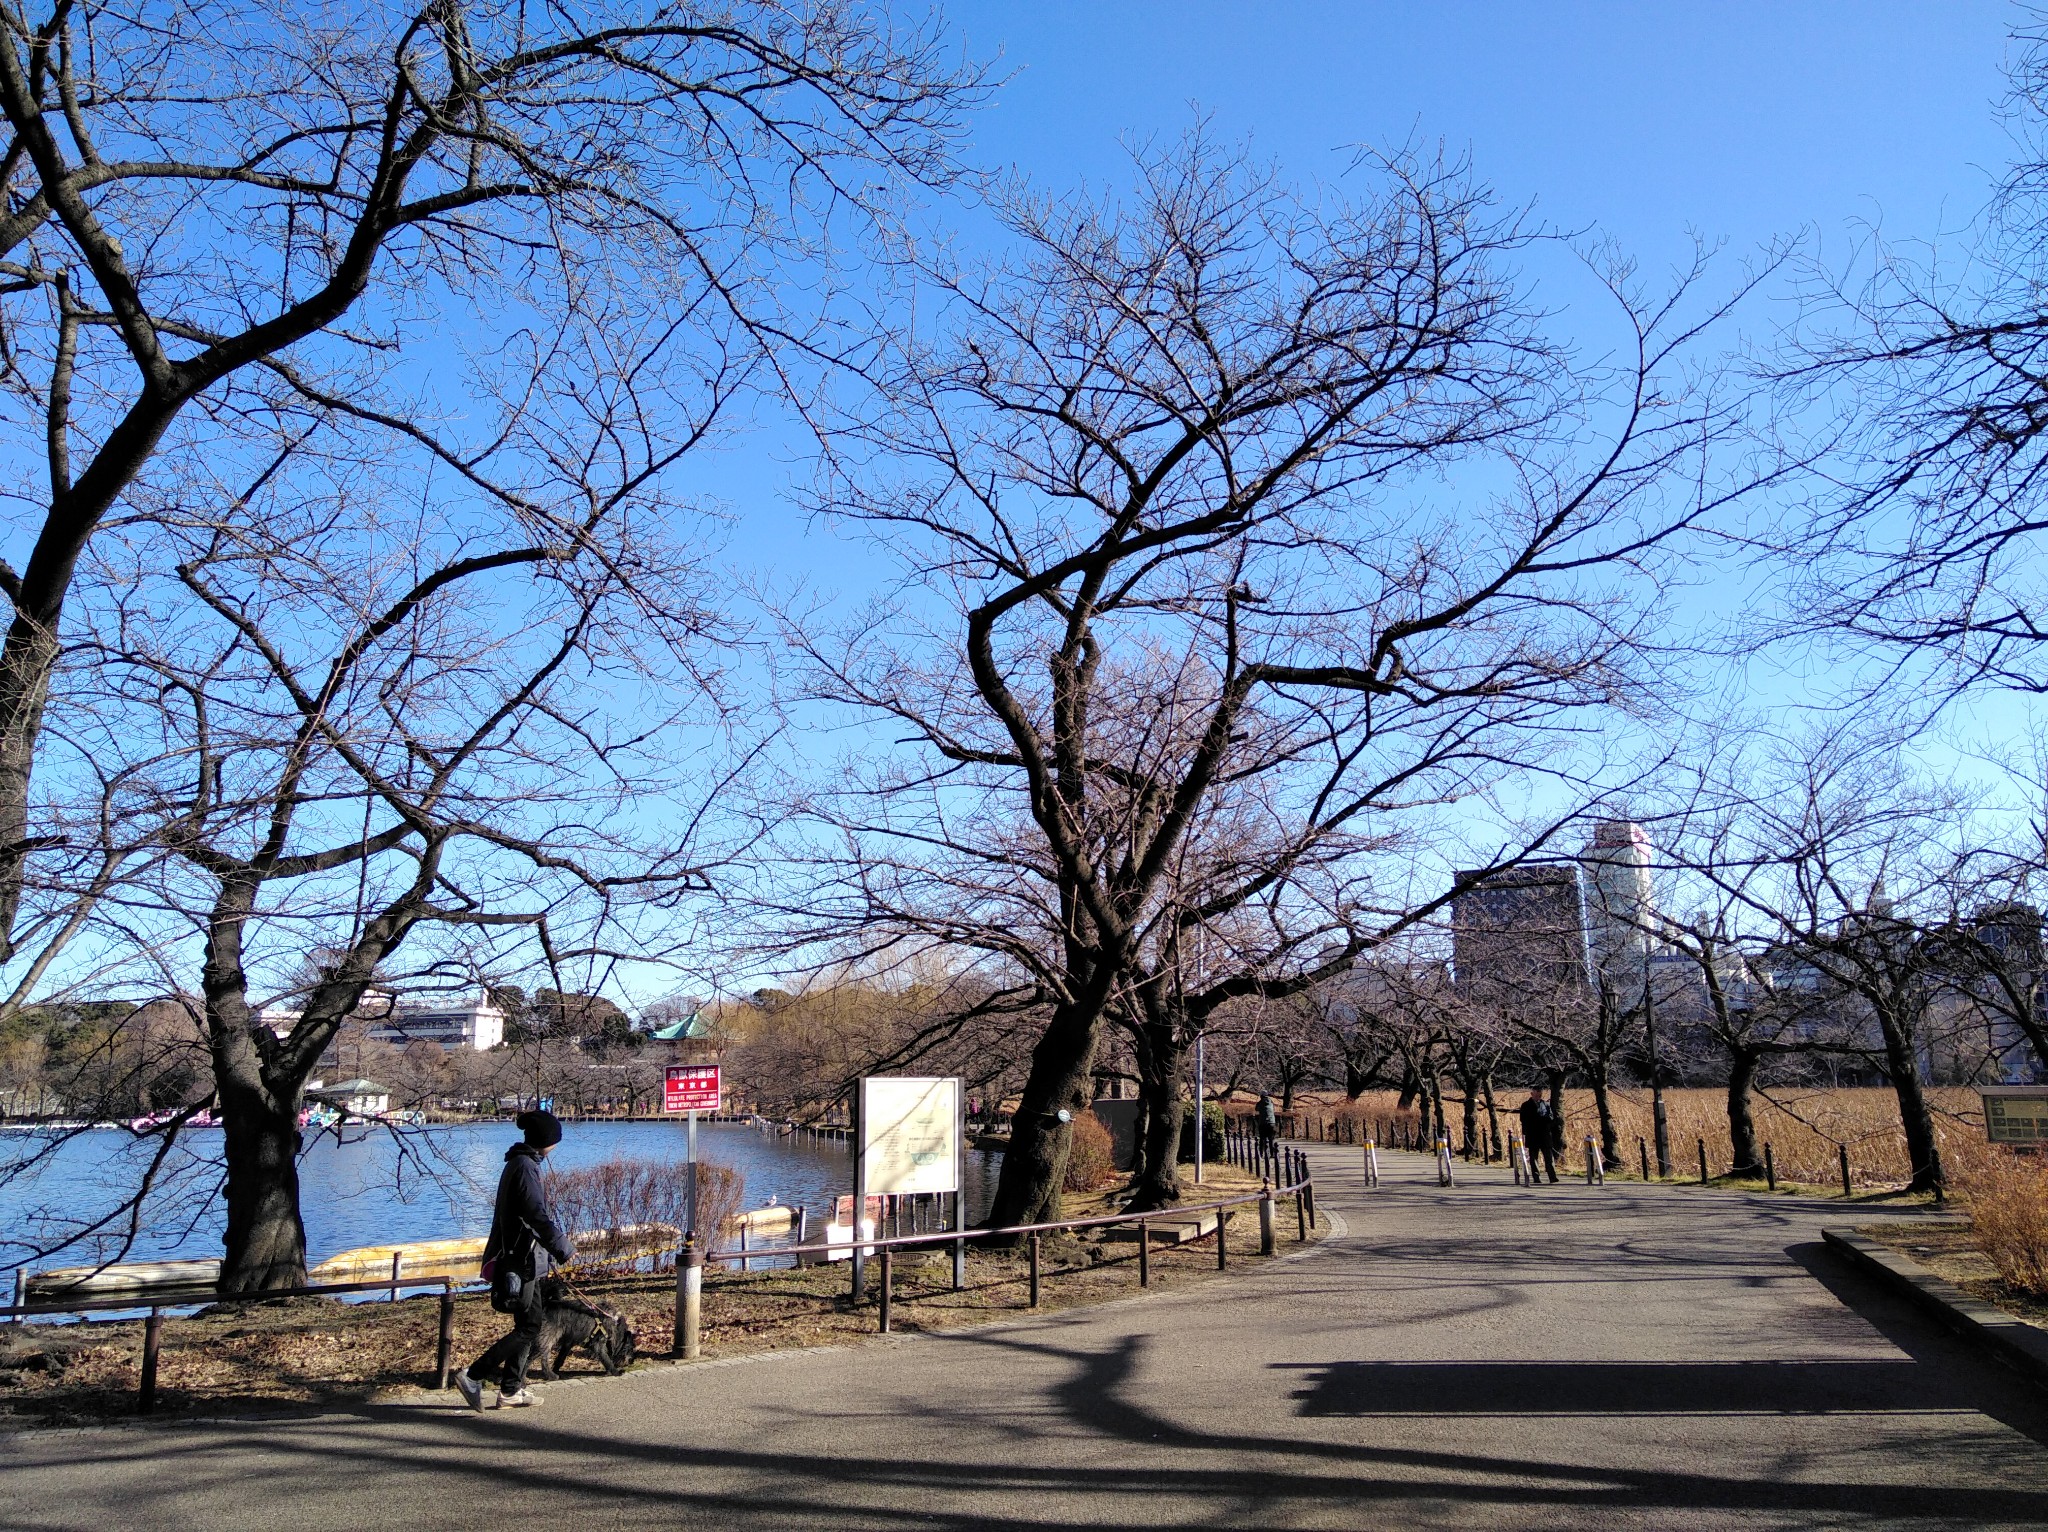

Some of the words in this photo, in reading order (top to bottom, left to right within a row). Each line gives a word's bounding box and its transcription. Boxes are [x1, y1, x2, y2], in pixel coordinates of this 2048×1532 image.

[669, 1068, 716, 1081] 鳥獣保護区
[678, 1081, 708, 1090] 東京都
